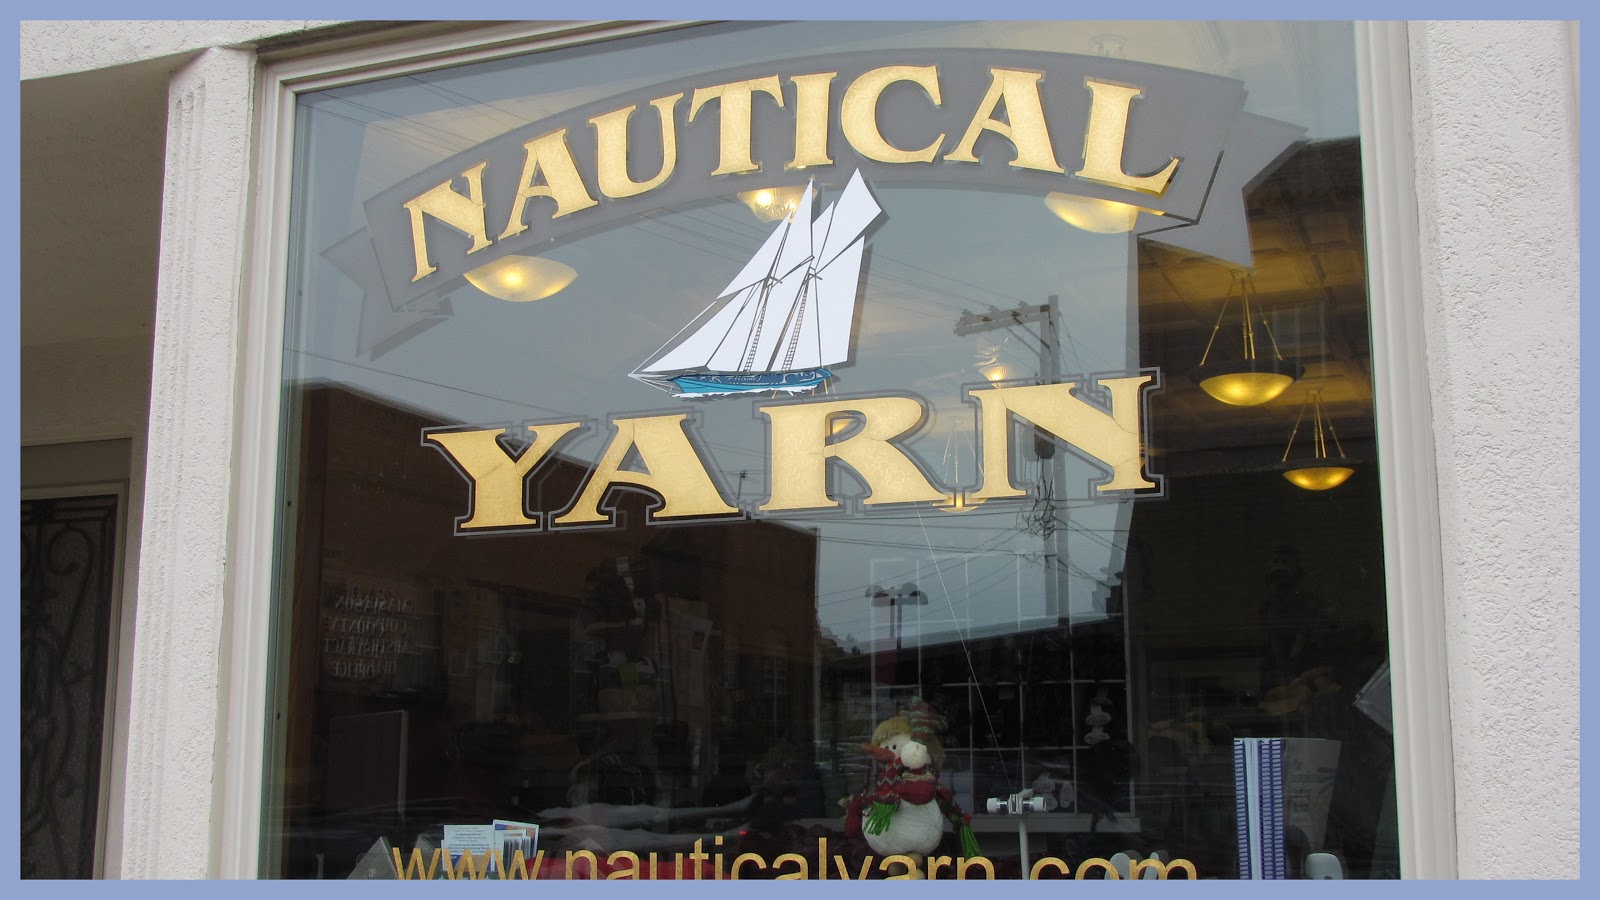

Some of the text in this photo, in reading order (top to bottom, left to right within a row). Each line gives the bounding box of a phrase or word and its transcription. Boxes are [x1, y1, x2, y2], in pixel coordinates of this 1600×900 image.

[403, 65, 1180, 283] NAUTICAL
[425, 375, 1158, 530] YARN
[392, 836, 1198, 880] wwwnauticalarncom
